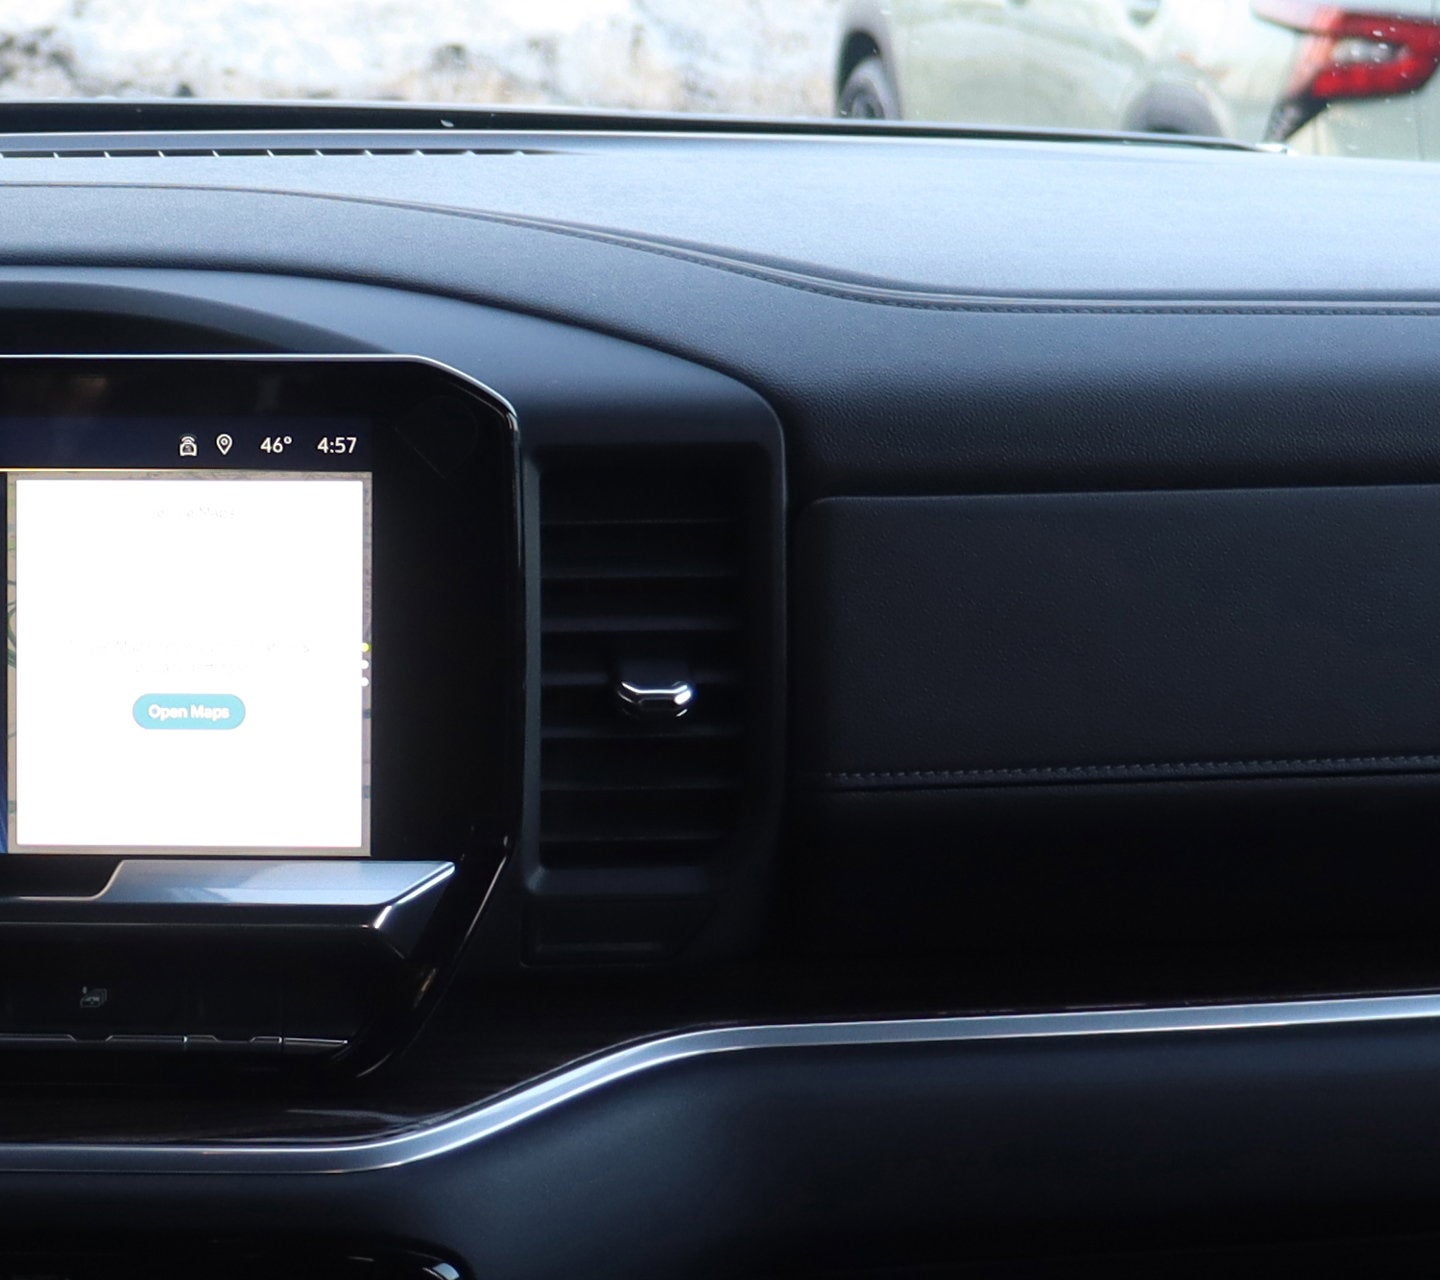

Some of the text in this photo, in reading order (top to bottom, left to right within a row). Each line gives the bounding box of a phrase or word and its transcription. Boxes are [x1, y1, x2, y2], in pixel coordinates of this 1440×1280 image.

[317, 437, 357, 454] 4:57
[148, 704, 230, 722] Open Maps
